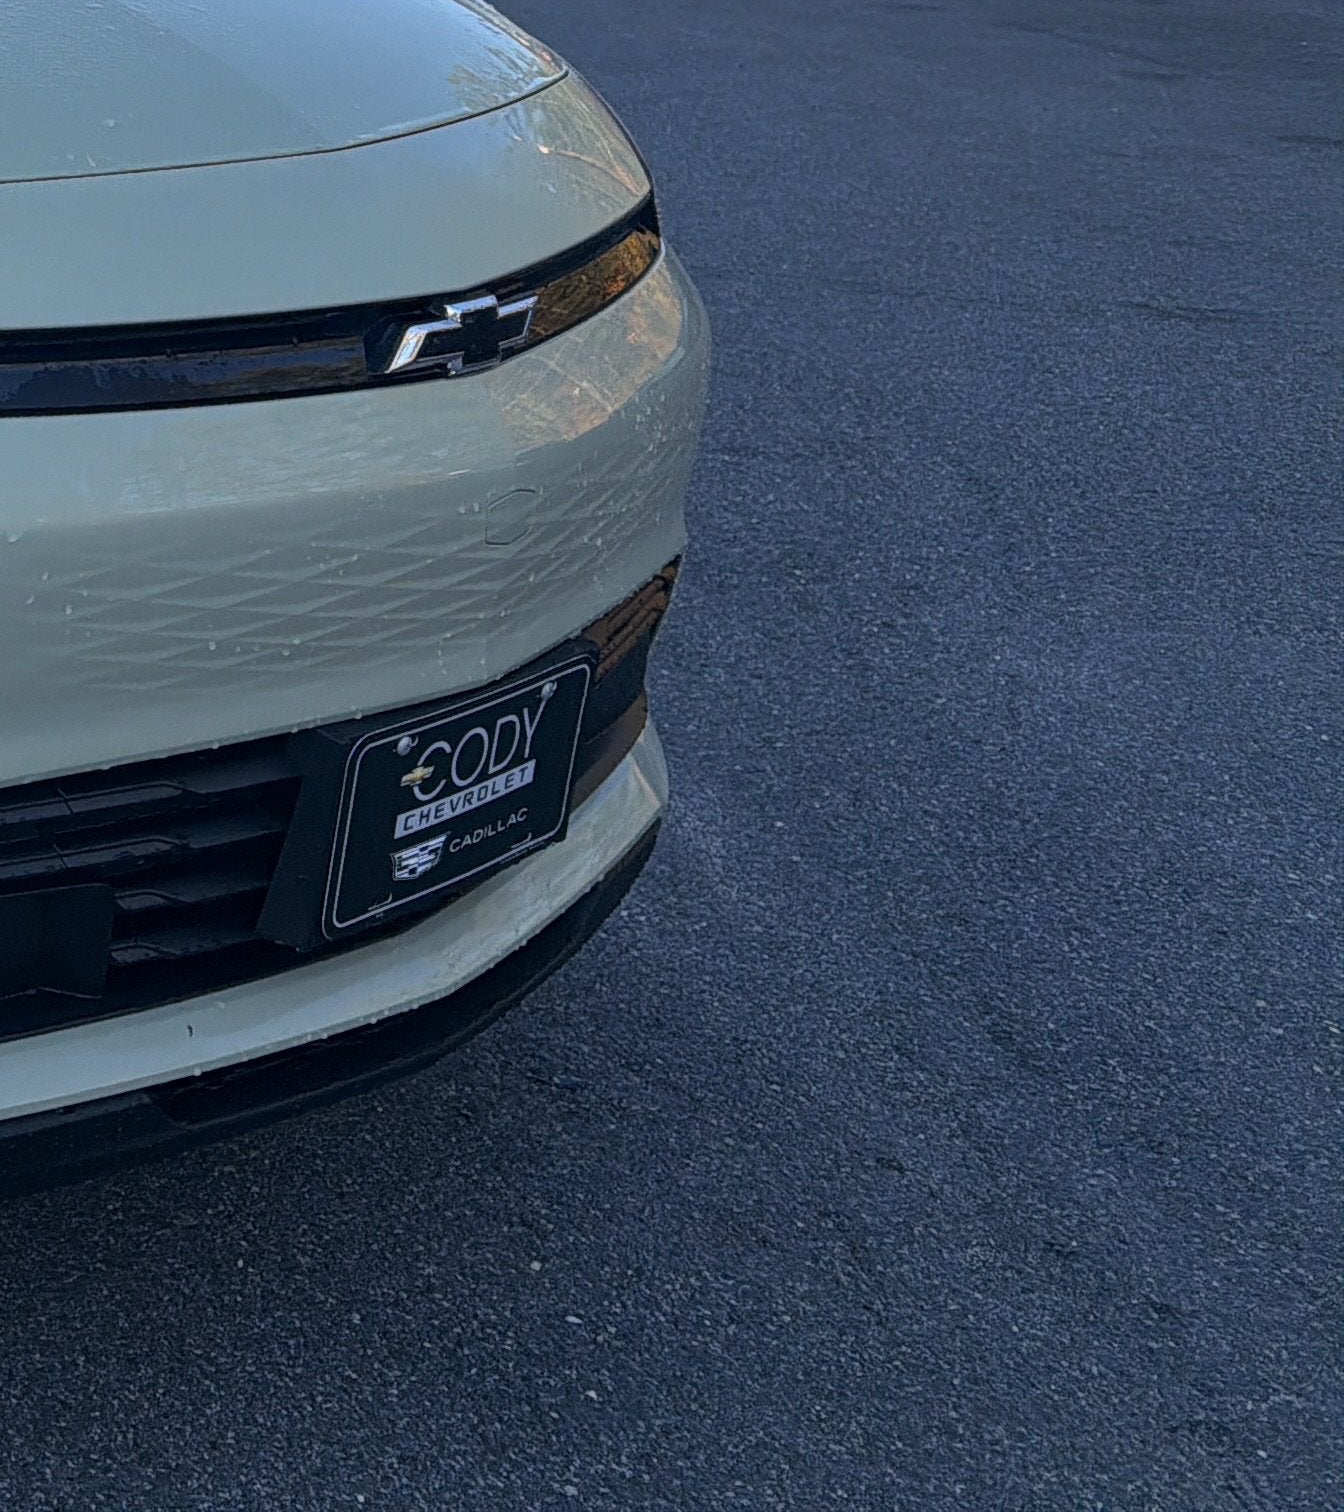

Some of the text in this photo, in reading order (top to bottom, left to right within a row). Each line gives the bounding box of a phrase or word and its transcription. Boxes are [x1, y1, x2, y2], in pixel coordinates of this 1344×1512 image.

[412, 696, 547, 802] CODY
[402, 765, 530, 832] CHEVROLET
[448, 807, 529, 853] CADILLAC
